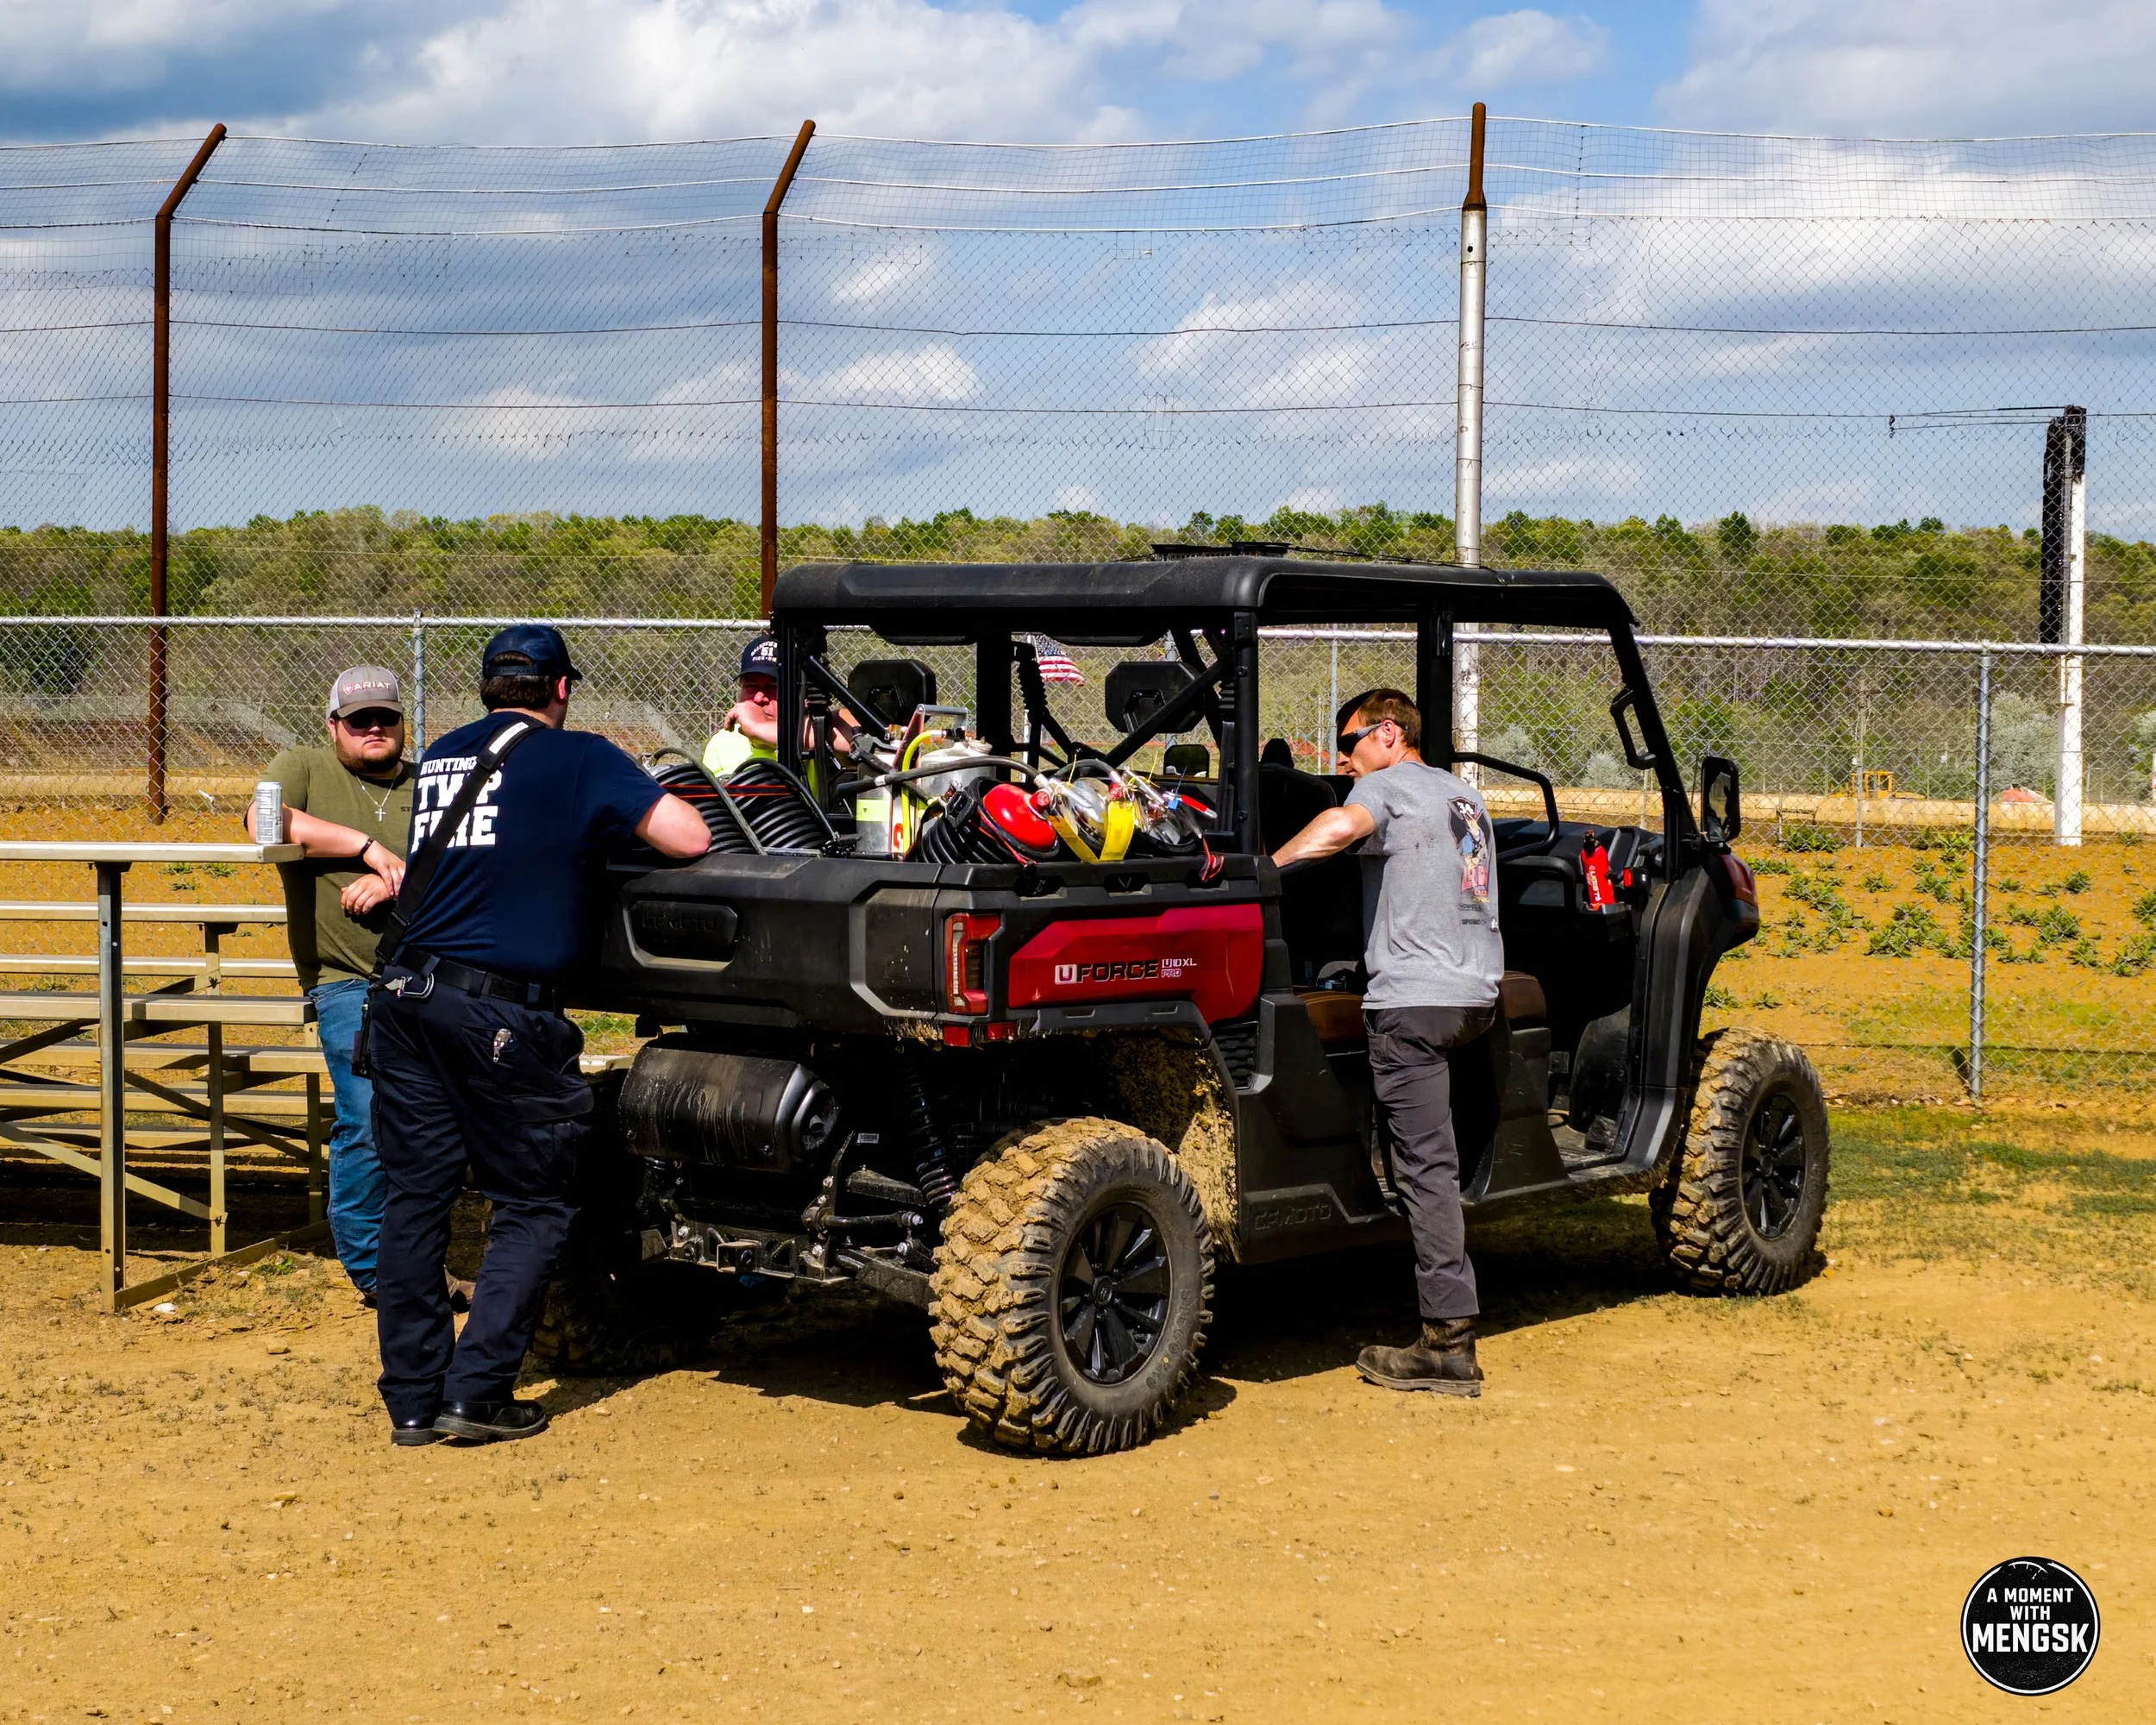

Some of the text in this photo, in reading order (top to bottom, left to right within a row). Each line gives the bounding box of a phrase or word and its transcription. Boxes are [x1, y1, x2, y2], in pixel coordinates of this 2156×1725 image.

[354, 681, 391, 691] ARIAT
[420, 756, 478, 775] HUNTING
[1161, 969, 1182, 978] PRO
